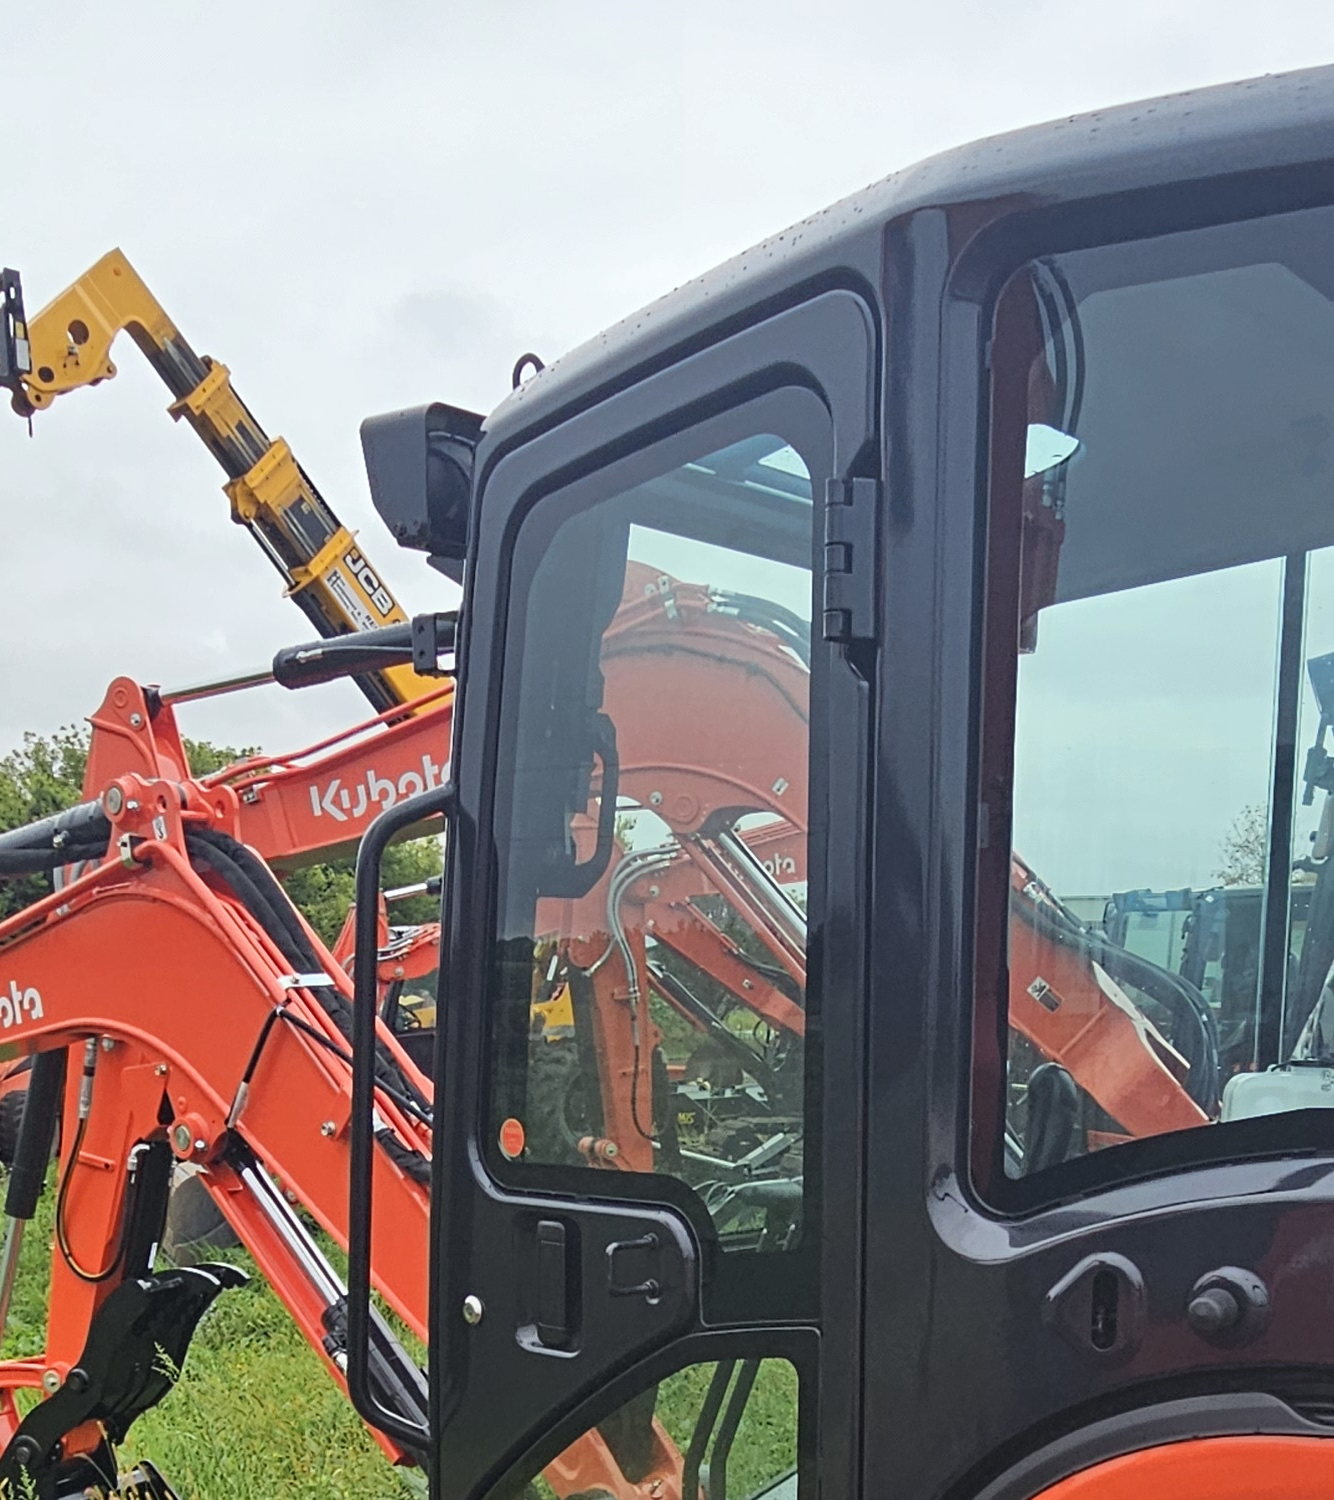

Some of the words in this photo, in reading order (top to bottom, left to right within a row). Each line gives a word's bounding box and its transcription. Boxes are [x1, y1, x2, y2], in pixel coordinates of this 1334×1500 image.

[344, 549, 395, 616] JCB
[309, 754, 451, 821] Kubot
[763, 853, 795, 875] ota
